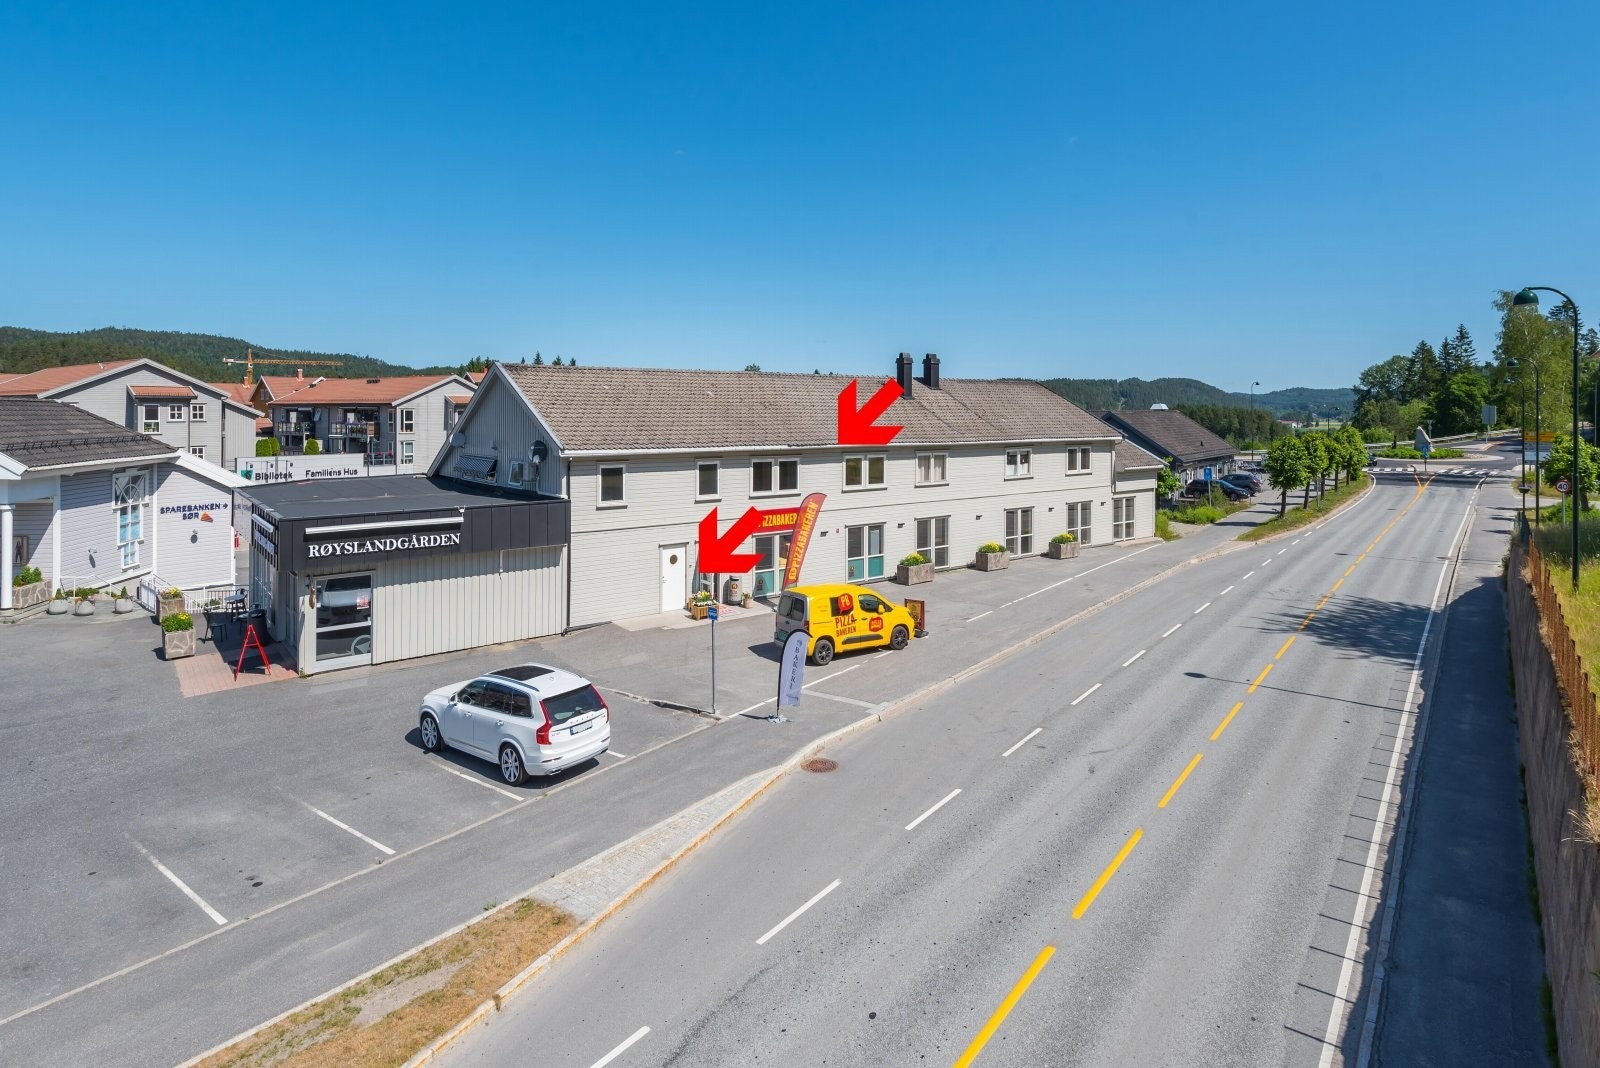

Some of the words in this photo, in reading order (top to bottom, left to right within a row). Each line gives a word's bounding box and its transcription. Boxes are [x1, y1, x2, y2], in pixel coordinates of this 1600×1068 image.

[255, 471, 293, 481] Bibliotek
[305, 468, 342, 478] Familiens
[343, 468, 358, 476] Hus
[160, 503, 221, 514] SPAREBANKEN
[182, 512, 199, 520] SØR
[760, 513, 797, 527] IZZABAKER
[308, 533, 461, 558] RØYSLANDGÅRDEN
[834, 613, 857, 629] PIZZA
